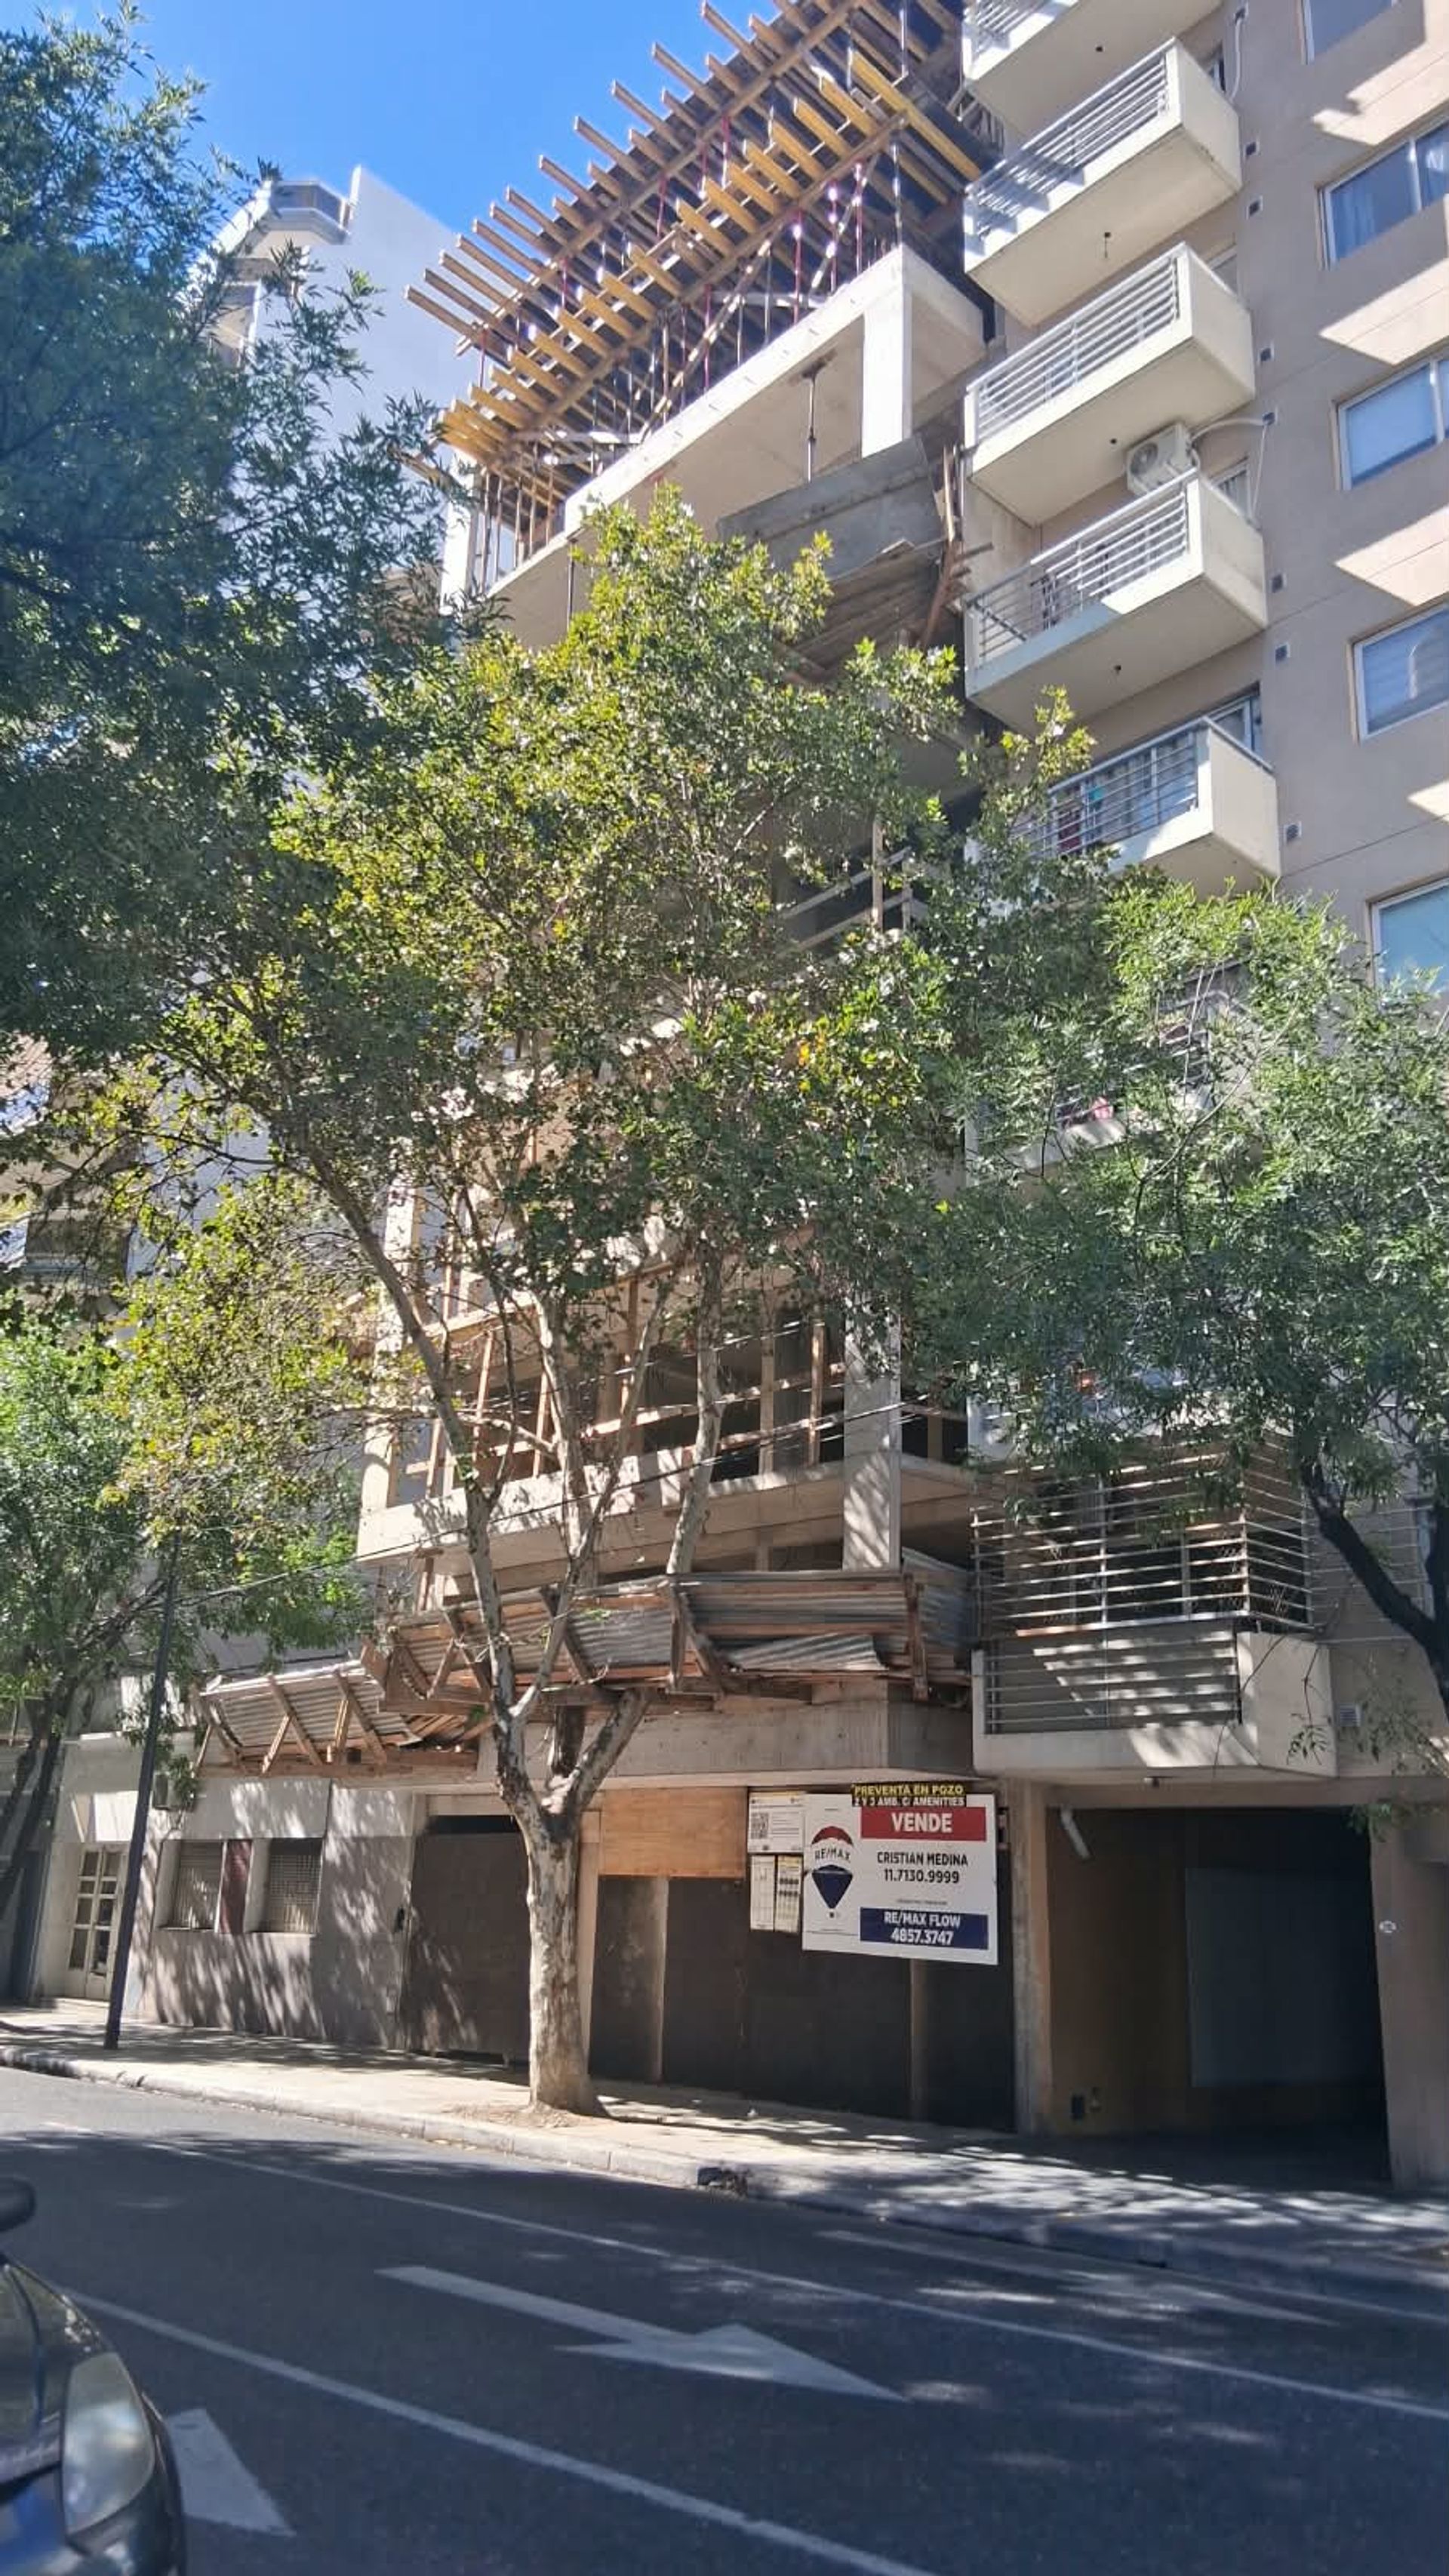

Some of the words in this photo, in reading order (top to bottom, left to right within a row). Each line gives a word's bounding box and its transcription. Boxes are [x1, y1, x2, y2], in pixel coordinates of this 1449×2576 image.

[854, 1785, 910, 1796] PREVENTA
[913, 1785, 928, 1795] EN
[932, 1785, 964, 1795] POZO
[913, 1796, 964, 1806] AMENITIES
[891, 1812, 952, 1833] VENDE
[814, 1848, 851, 1860] RE/MAX
[877, 1851, 924, 1865] CRISTIAN
[927, 1853, 968, 1866] MEDINA
[884, 1911, 927, 1926] RE/MAX
[929, 1915, 961, 1928] FLOW
[891, 1928, 954, 1945] 4857.3747
